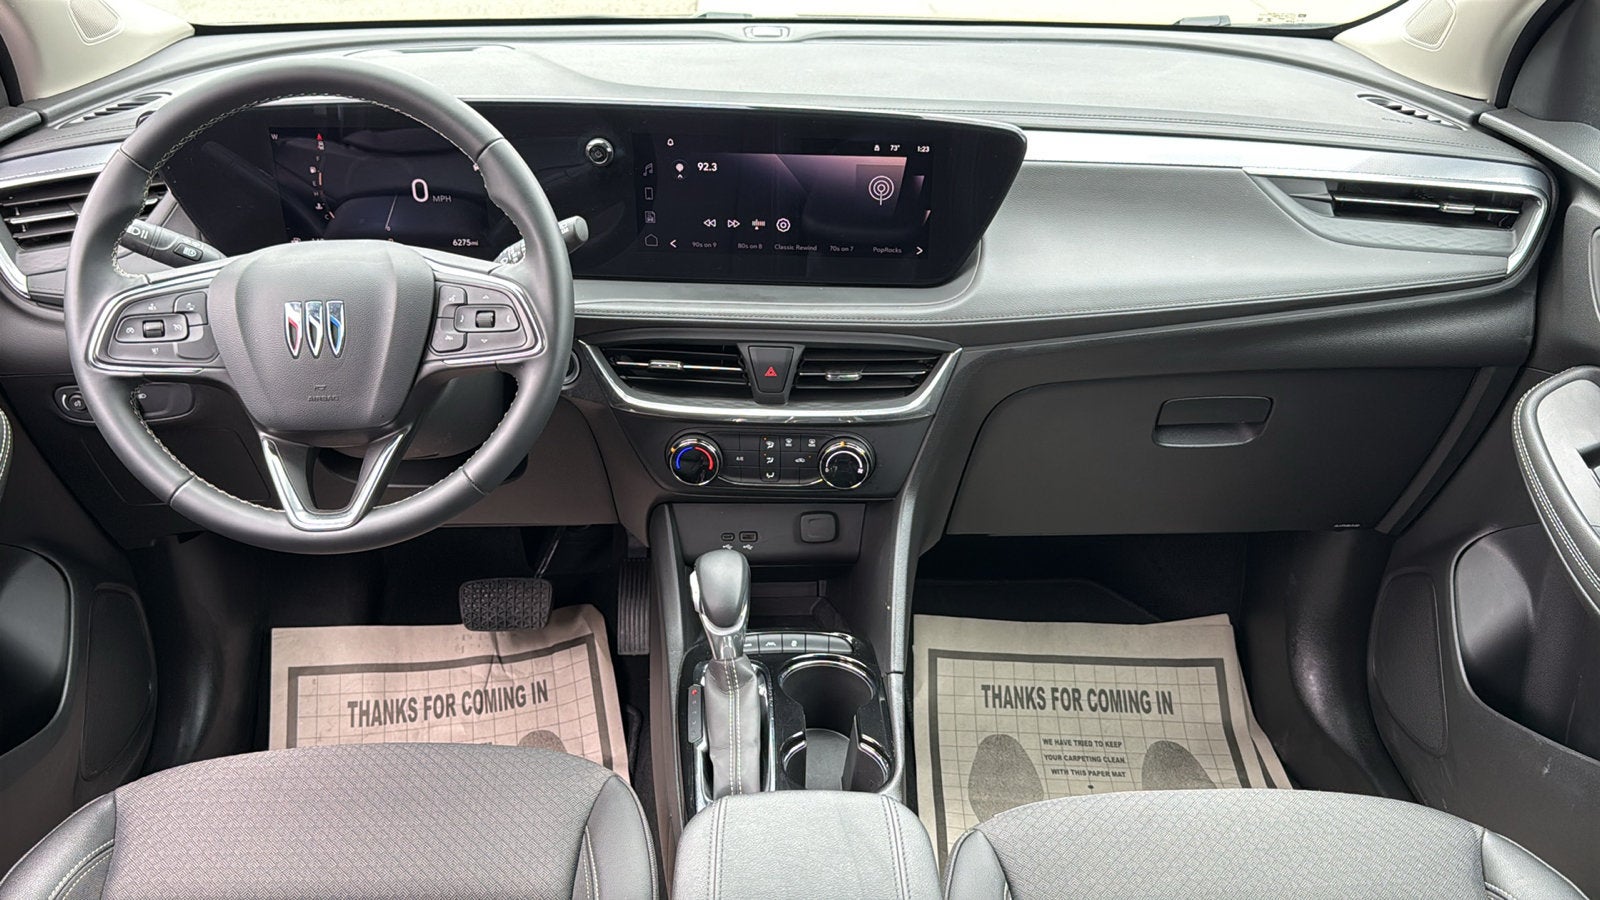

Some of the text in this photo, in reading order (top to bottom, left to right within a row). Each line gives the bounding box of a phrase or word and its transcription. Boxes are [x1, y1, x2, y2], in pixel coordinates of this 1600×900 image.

[697, 162, 718, 172] 92.3
[411, 178, 452, 203] 0 MPH
[872, 246, 902, 254] PopRocks
[347, 679, 549, 728] THANKS FOR COMING IN
[981, 684, 1175, 716] THANKS FOR COMING IN
[1042, 738, 1122, 749] WE HAVE TRIED TO KEEP
[1063, 755, 1102, 763] CARPETING
